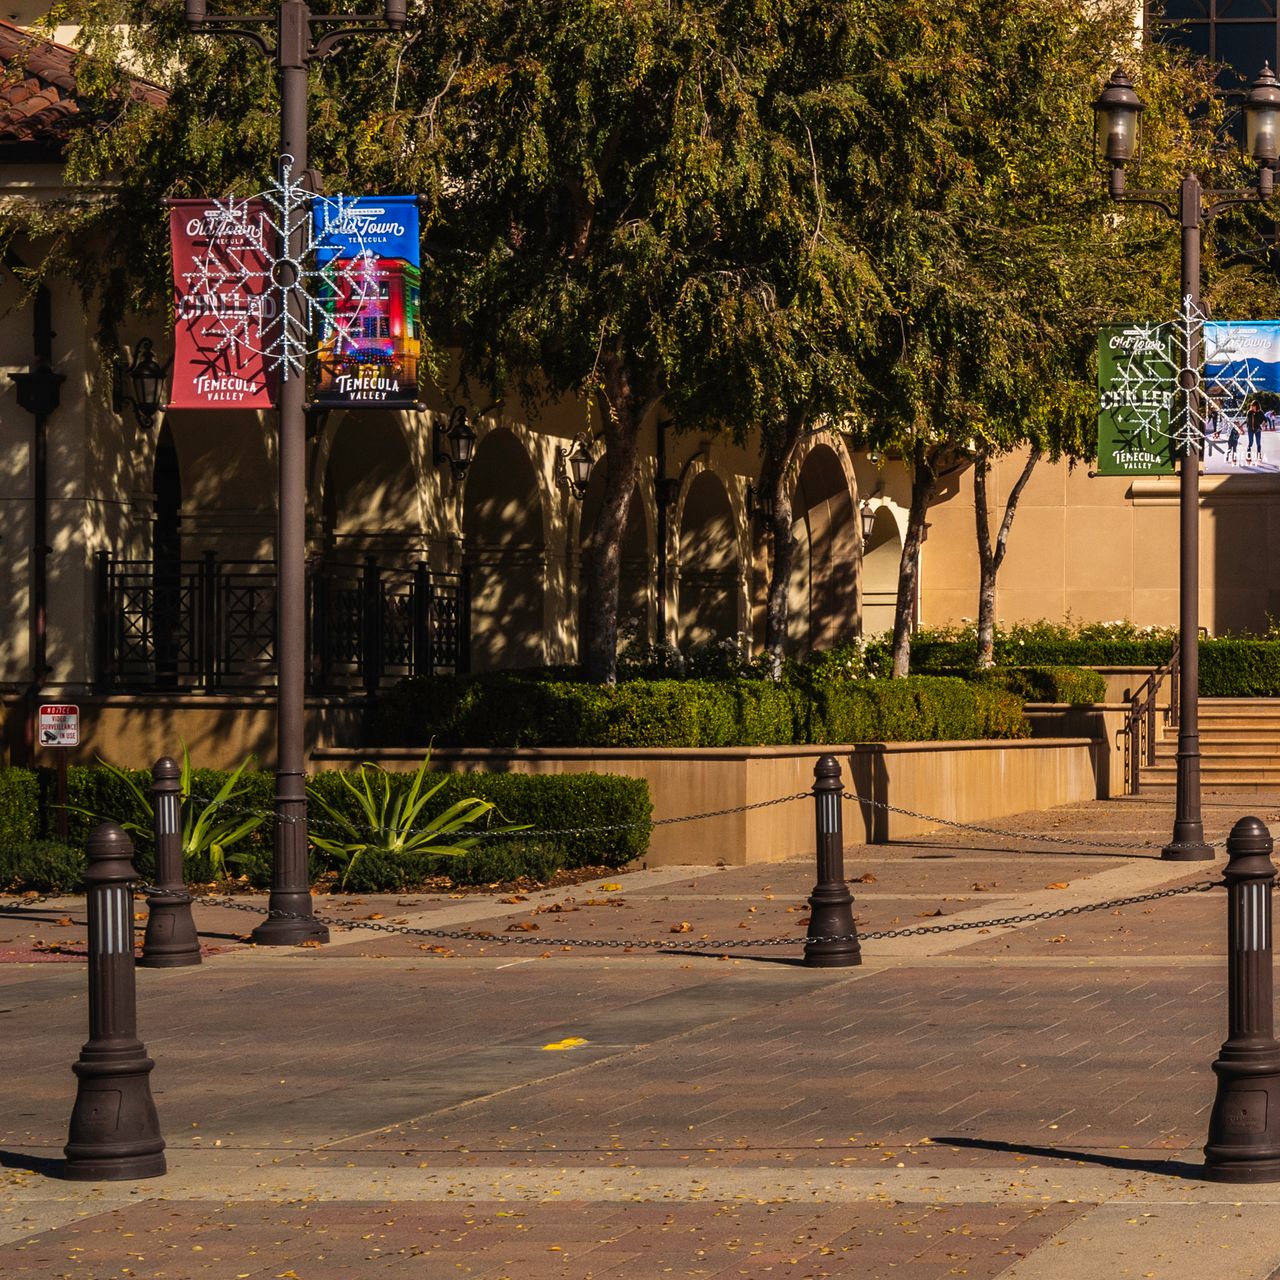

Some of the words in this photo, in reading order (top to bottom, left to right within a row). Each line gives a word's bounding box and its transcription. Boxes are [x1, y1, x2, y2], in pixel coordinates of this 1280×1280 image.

[357, 216, 405, 237] Town
[1109, 336, 1134, 350] Old
[193, 375, 257, 394] TEMECULA
[335, 374, 400, 394] TEMECULA
[207, 392, 244, 401] VALLEY
[350, 391, 387, 400] VALLEY
[1100, 390, 1175, 410] CHILLED
[1112, 449, 1162, 465] TEMECULA
[1124, 462, 1152, 470] VALLEY
